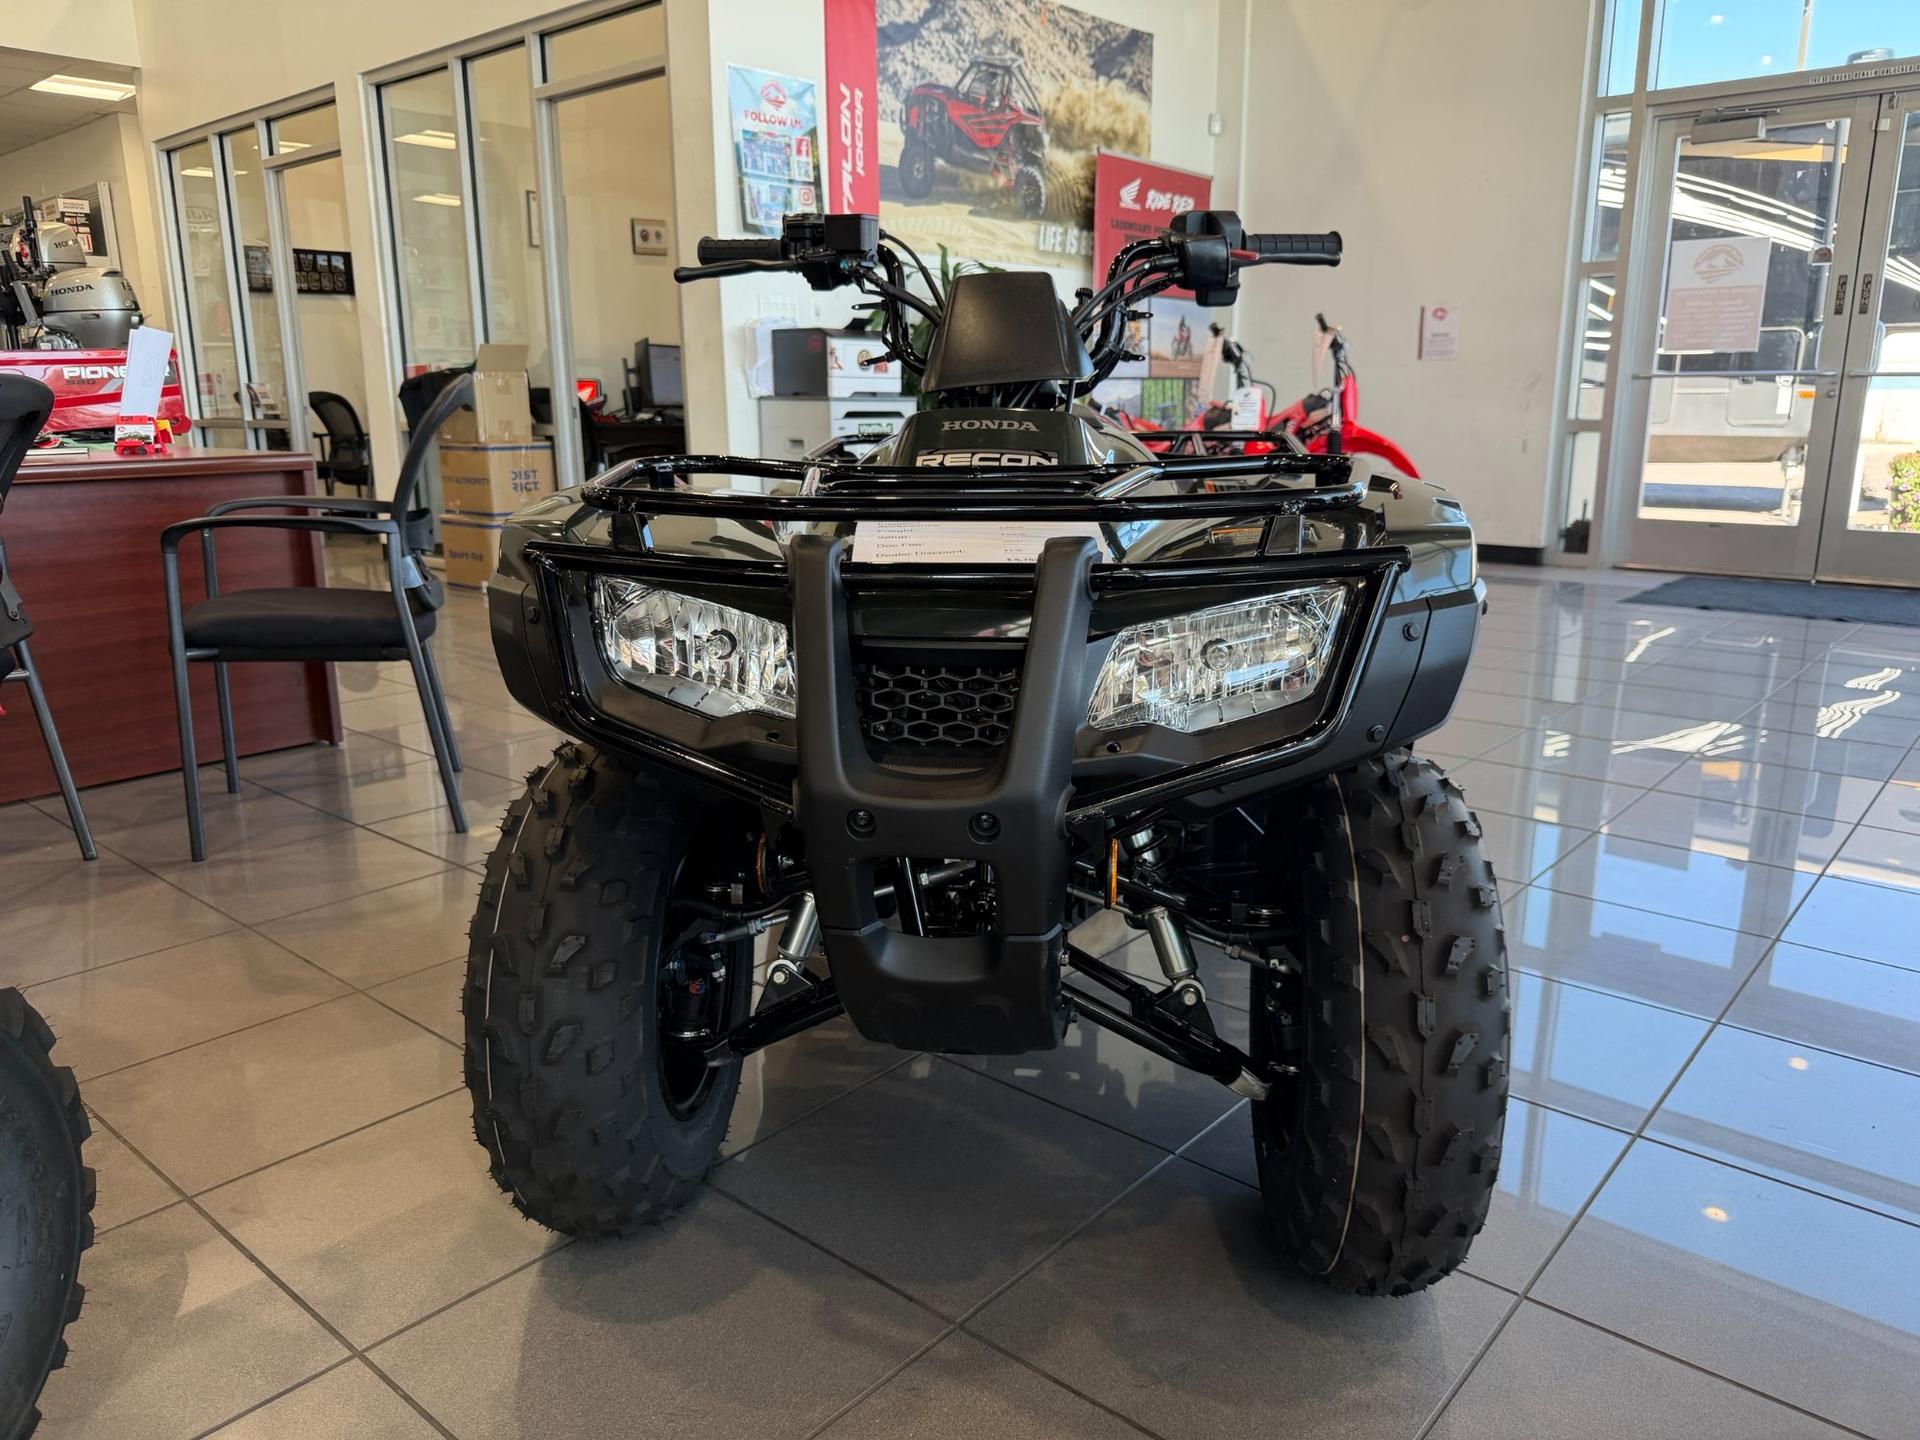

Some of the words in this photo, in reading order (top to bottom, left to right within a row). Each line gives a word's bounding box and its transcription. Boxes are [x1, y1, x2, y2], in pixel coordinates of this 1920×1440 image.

[744, 110, 787, 127] FOLLOW
[854, 87, 866, 177] 1000R
[1039, 223, 1064, 253] LIFE
[1066, 226, 1079, 256] IS
[50, 284, 94, 297] HONDA
[941, 420, 1040, 432] HONDA
[916, 452, 1058, 467] RECON
